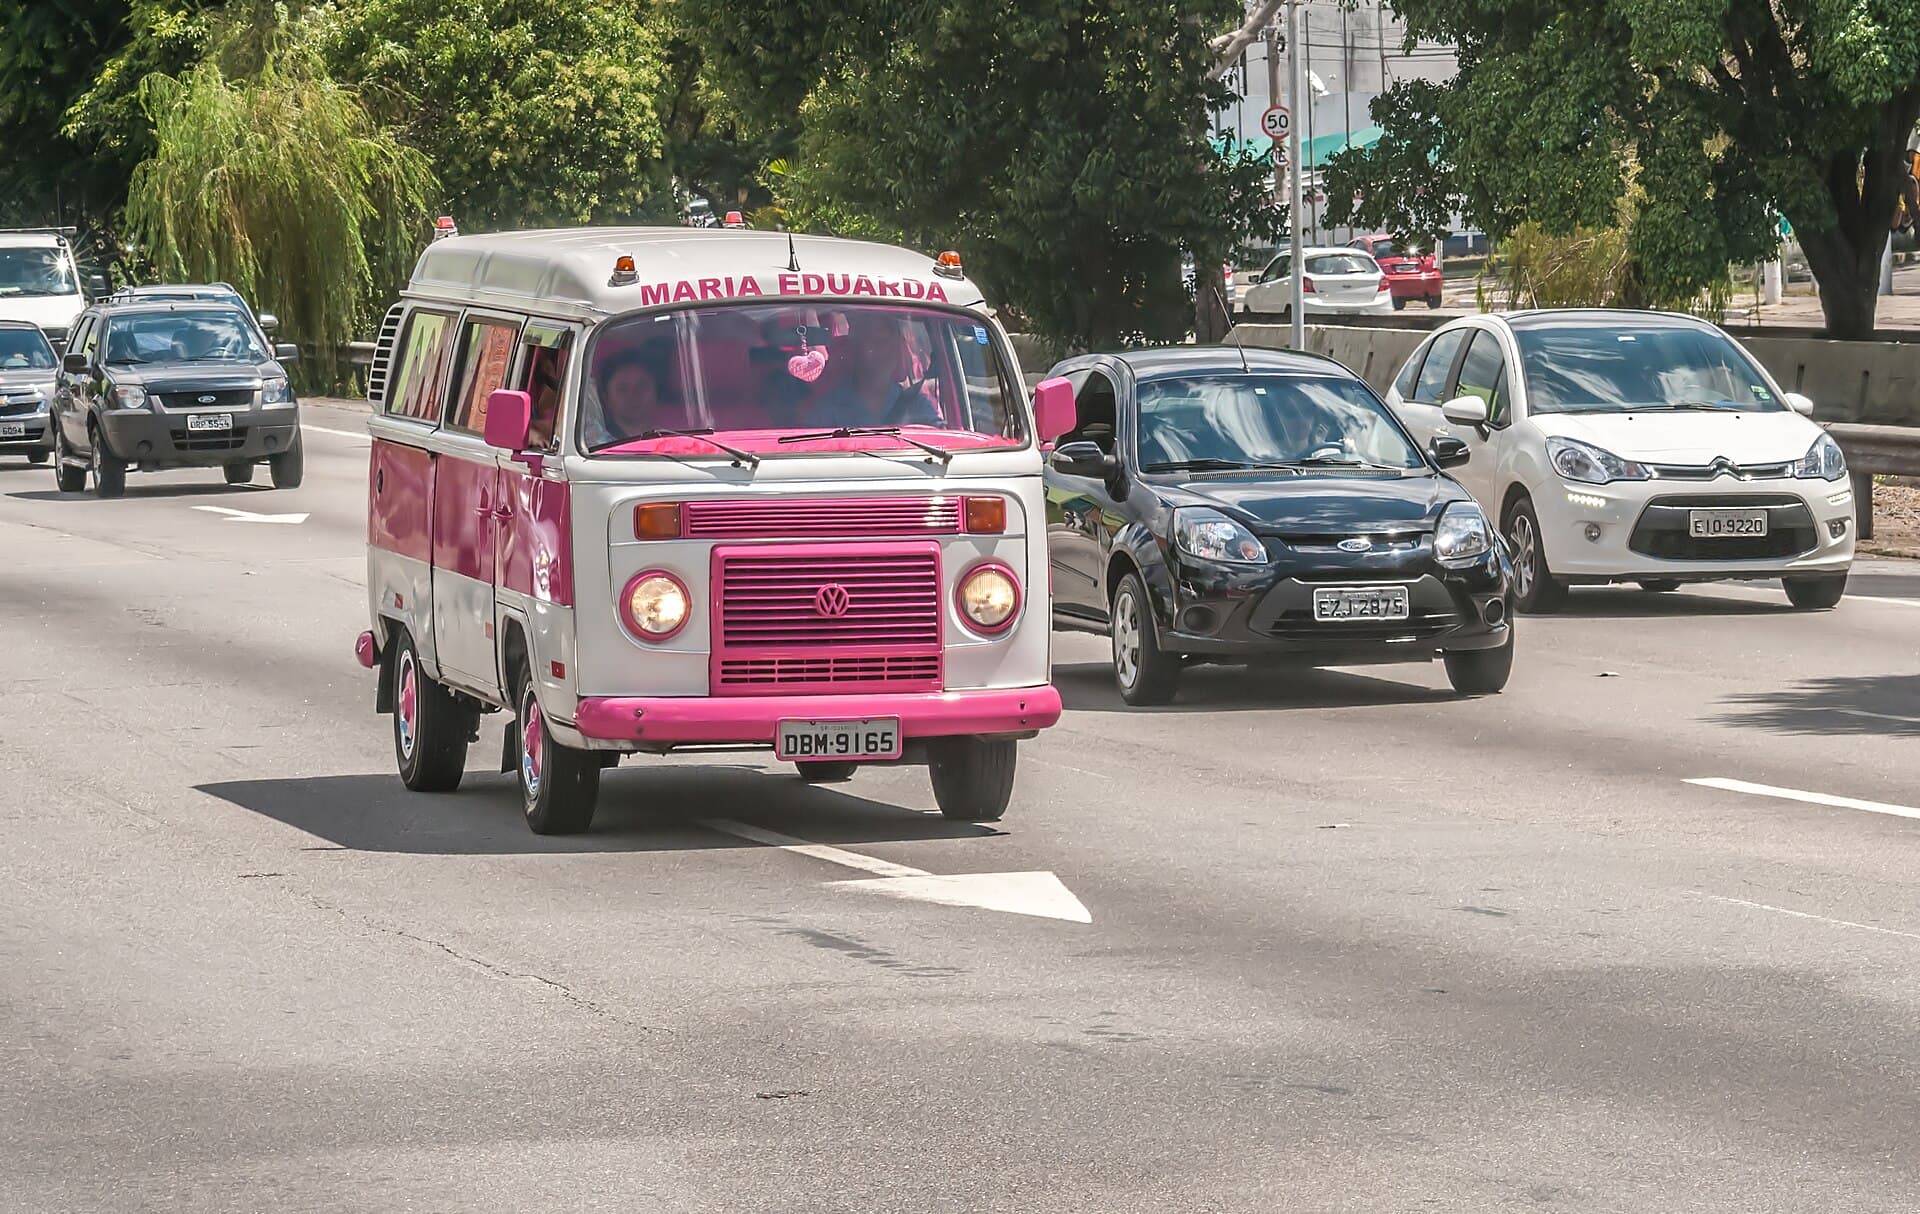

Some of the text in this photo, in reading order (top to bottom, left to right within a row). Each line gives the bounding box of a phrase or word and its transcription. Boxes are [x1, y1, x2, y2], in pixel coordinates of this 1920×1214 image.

[1267, 114, 1289, 129] 50
[640, 273, 949, 306] MARIA EDUARDA
